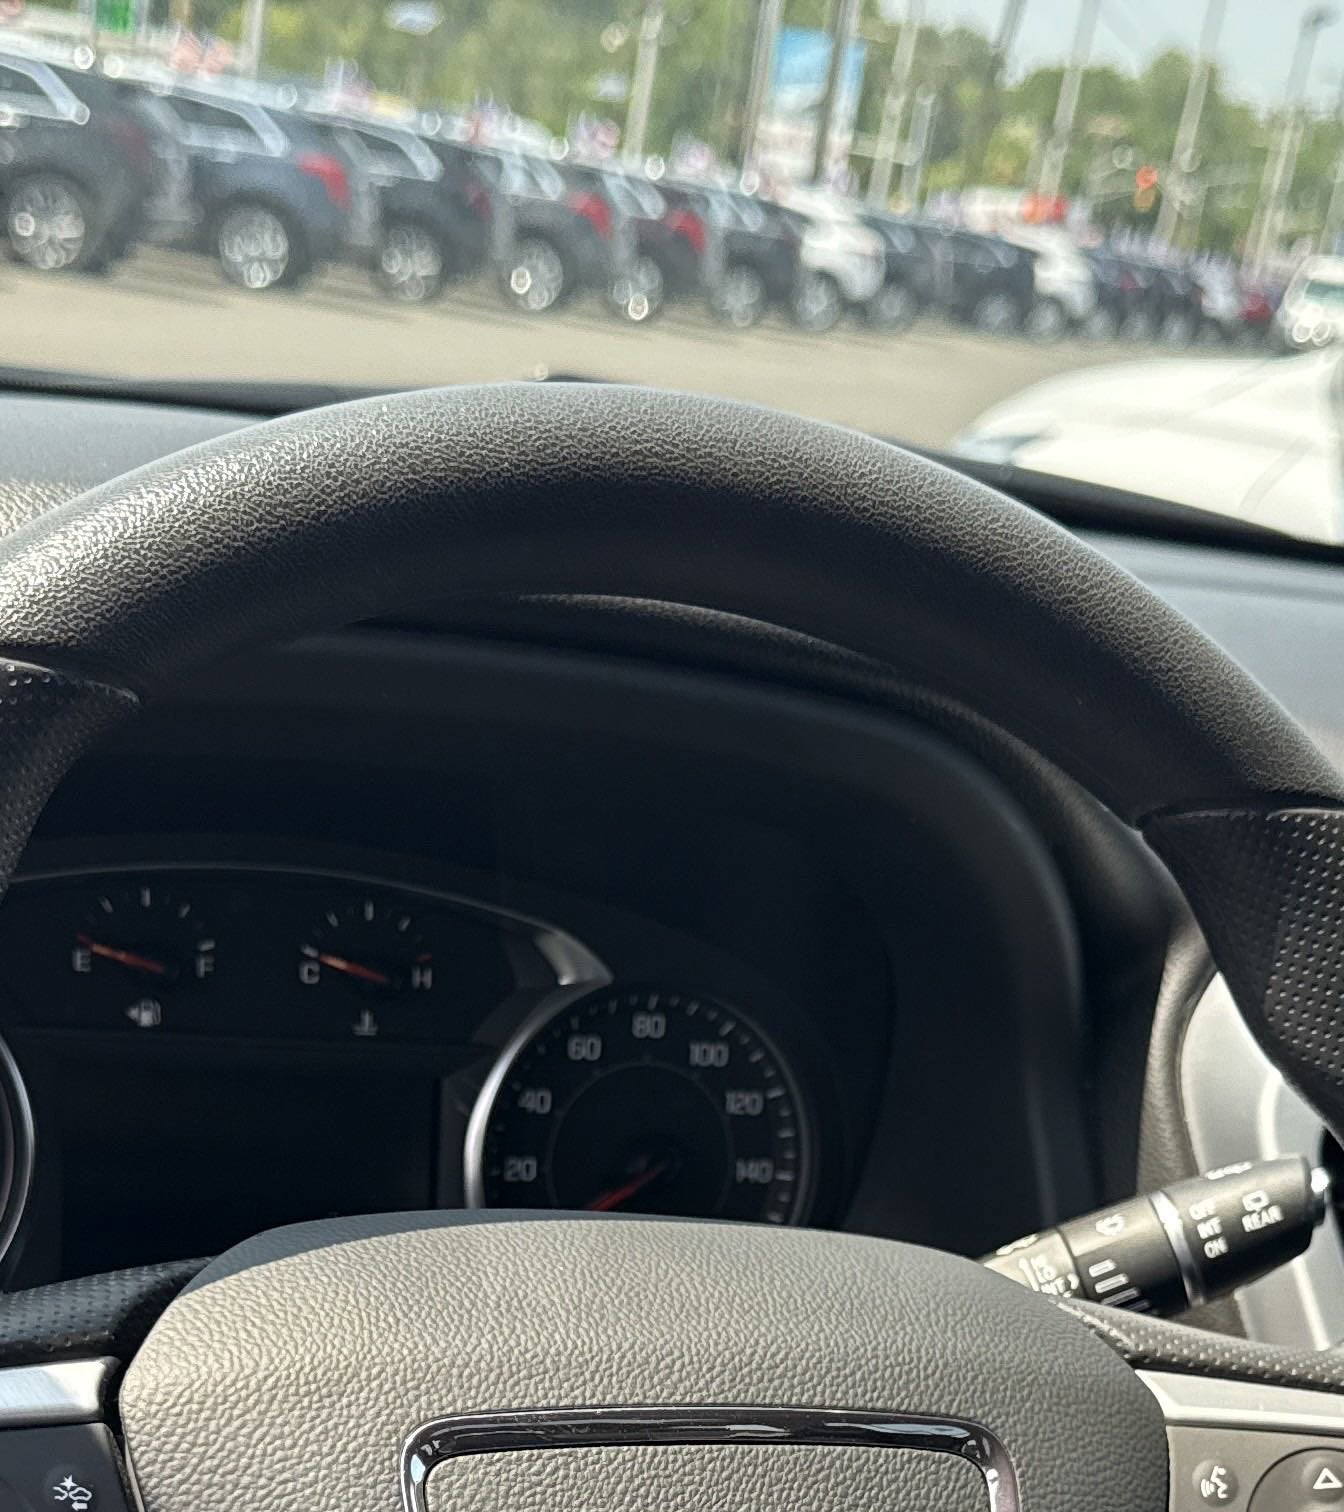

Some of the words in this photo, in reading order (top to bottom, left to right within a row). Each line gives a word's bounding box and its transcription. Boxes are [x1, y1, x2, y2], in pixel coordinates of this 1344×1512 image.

[72, 949, 91, 973] E
[196, 954, 214, 979] F
[299, 960, 320, 985] C
[412, 966, 432, 990] H
[632, 1012, 666, 1039] 80
[567, 1035, 602, 1061] 60
[689, 1041, 729, 1066] 100
[518, 1090, 552, 1114] 40
[725, 1091, 763, 1115] 120
[505, 1158, 537, 1182] 20
[736, 1159, 774, 1183] 140
